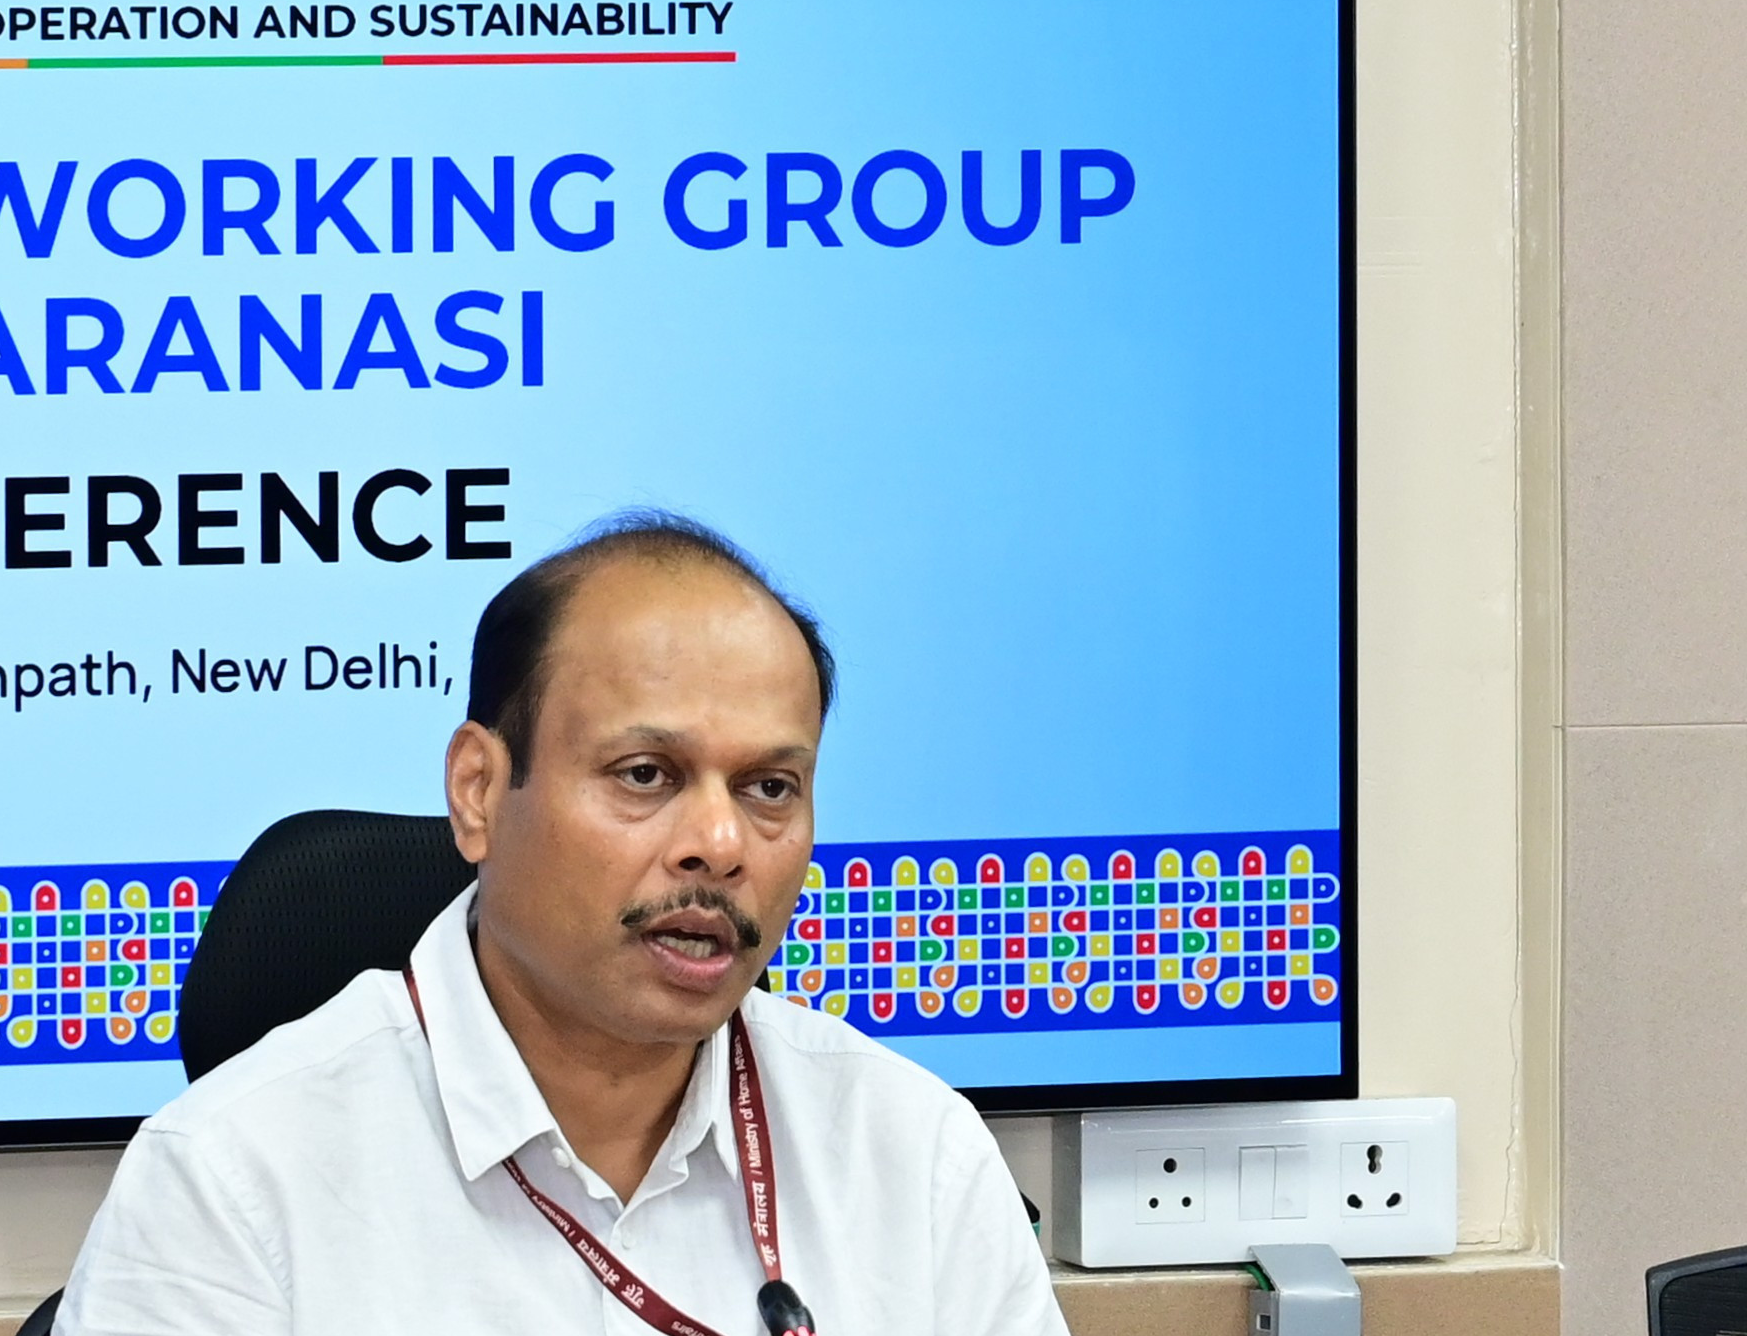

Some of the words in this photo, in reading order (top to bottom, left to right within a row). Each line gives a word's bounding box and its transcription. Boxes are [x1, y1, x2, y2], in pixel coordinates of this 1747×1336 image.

[252, 4, 357, 39] AND
[369, 0, 735, 38] SUSTAINABILITY
[663, 148, 1136, 251] GROUP
[171, 647, 288, 695] New
[304, 640, 453, 697] Delhi,
[734, 1034, 747, 1072] Affairs
[737, 1072, 752, 1107] Home
[738, 1107, 754, 1121] of
[744, 1122, 762, 1169] Ministry
[534, 1191, 571, 1232] Ministry
[751, 1180, 769, 1238] मंत्रालय
[575, 1238, 622, 1287] मंत्रालय
[624, 1284, 646, 1309] गृह
